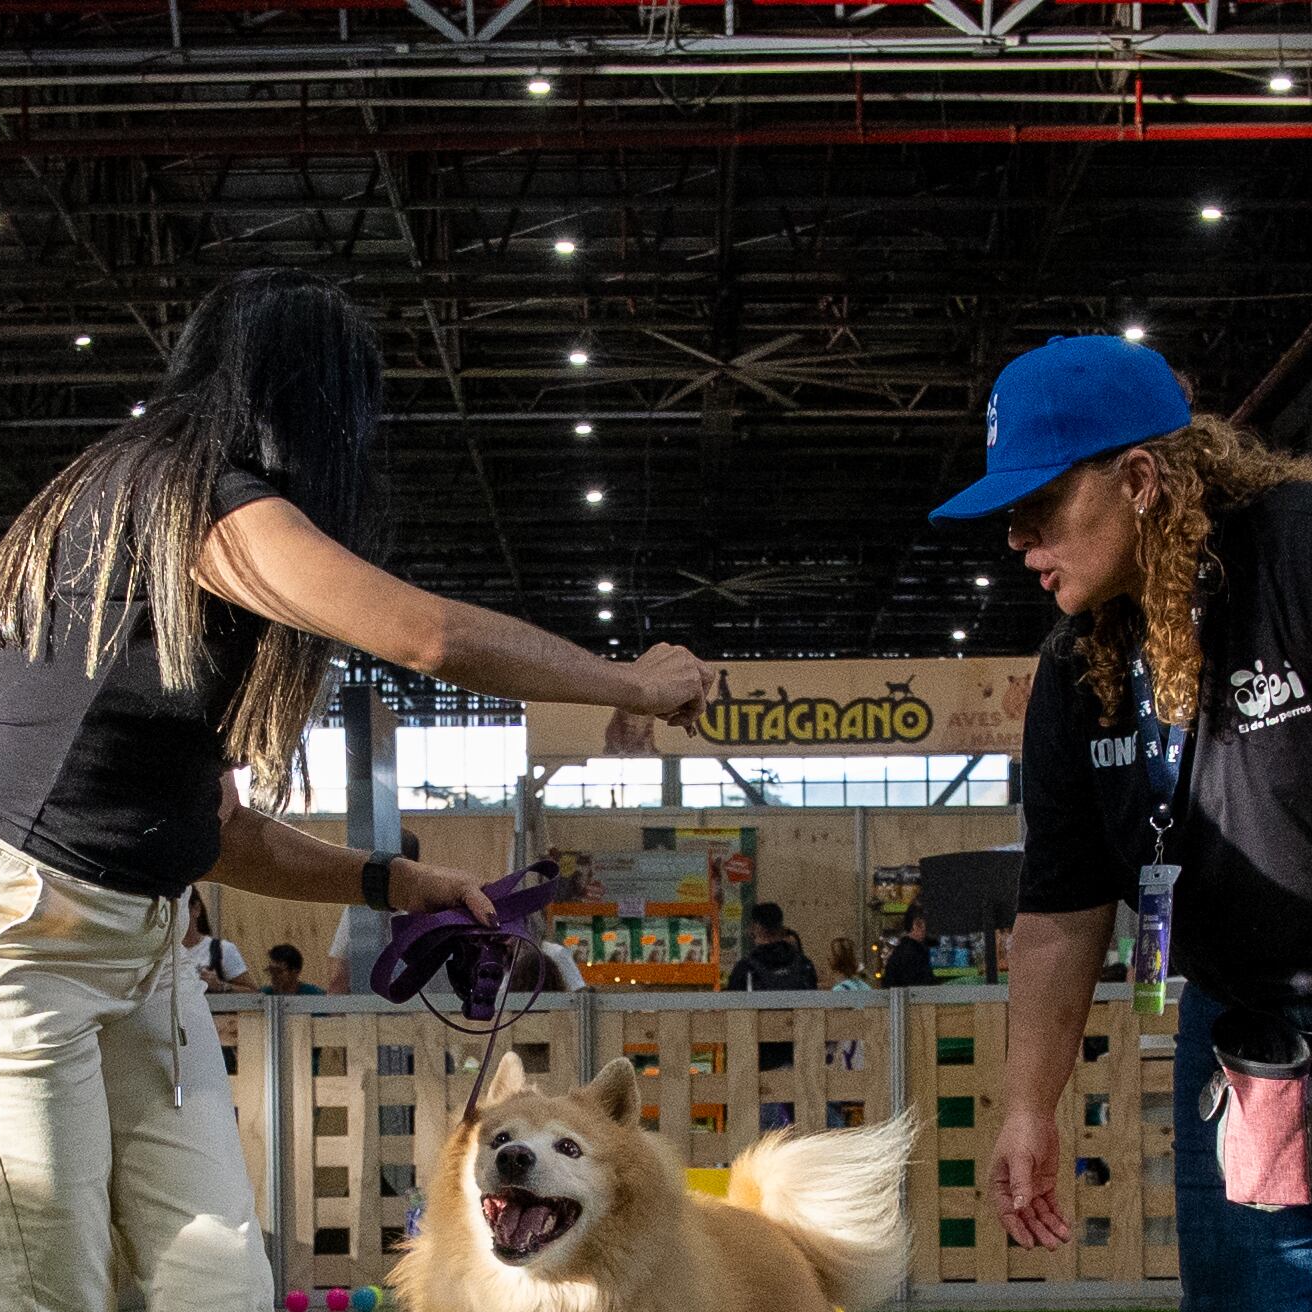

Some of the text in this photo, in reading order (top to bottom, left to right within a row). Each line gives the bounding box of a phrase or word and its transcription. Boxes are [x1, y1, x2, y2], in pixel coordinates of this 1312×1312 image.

[698, 702, 930, 742] VITAGRANO
[948, 711, 1001, 727] AVES
[1250, 721, 1264, 731] de
[1265, 716, 1279, 726] los
[1278, 705, 1312, 722] perros
